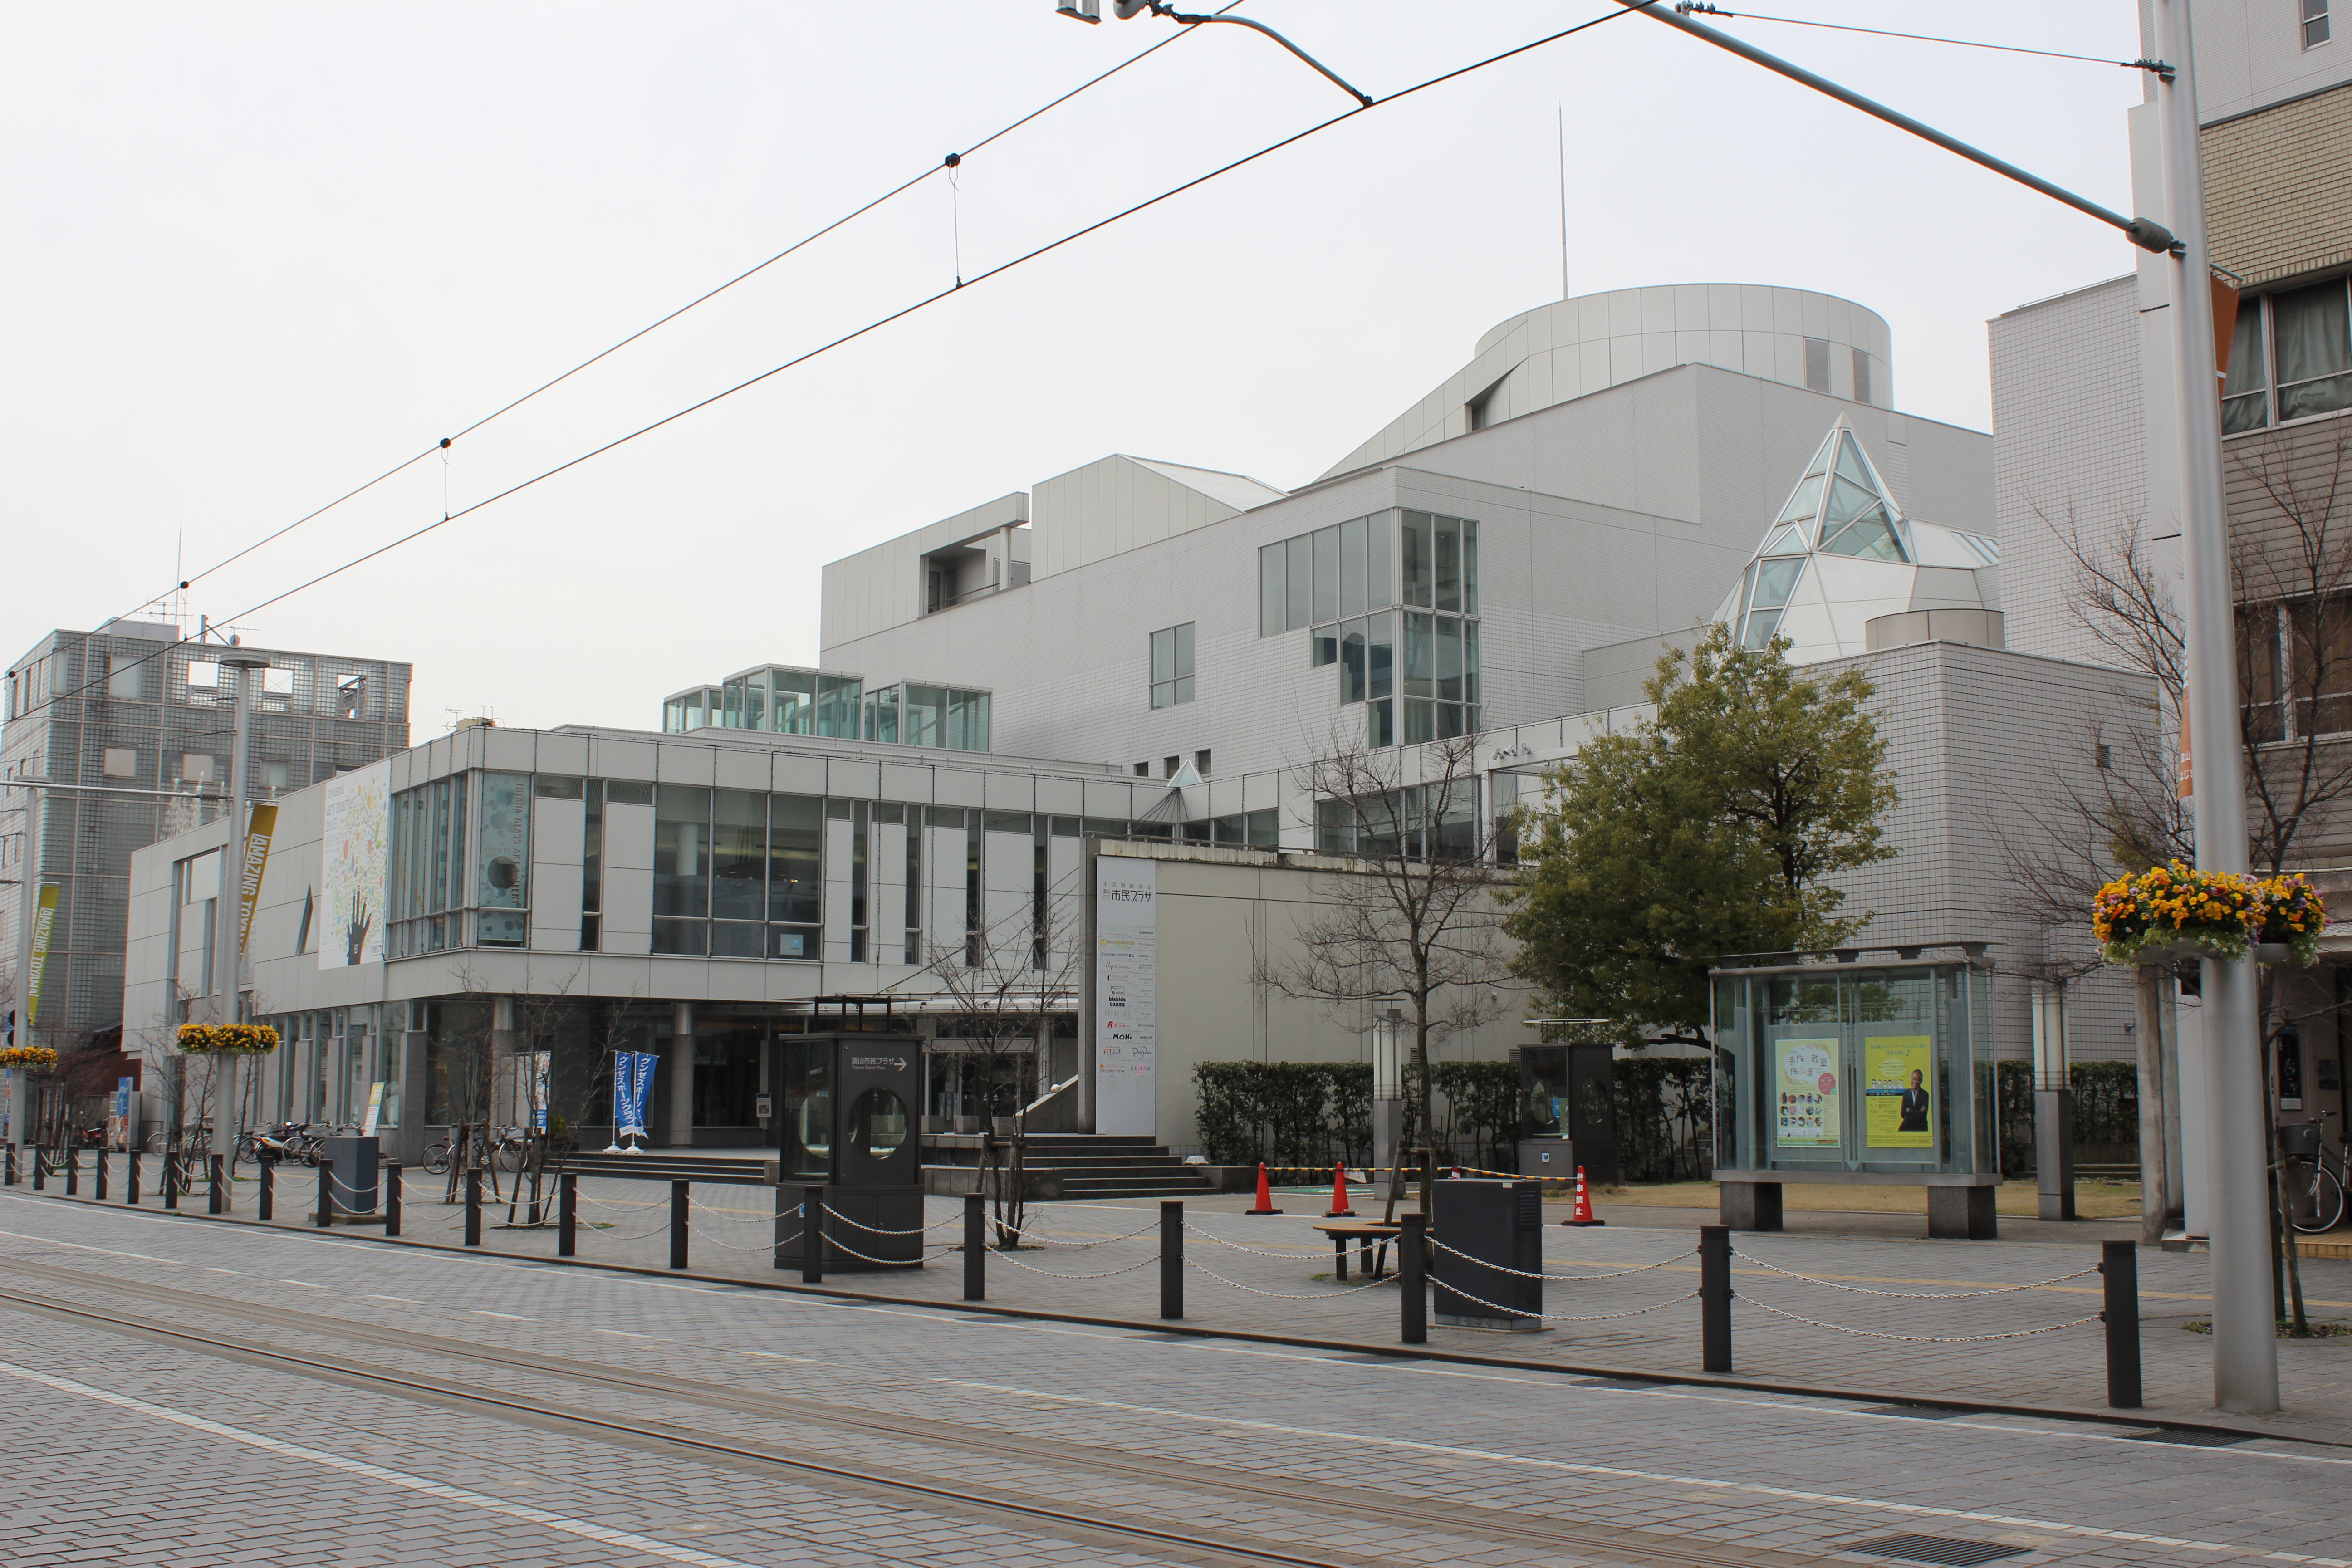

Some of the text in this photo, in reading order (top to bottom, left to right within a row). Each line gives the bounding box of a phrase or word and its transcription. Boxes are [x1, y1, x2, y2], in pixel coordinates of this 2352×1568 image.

[328, 786, 344, 800] toyama
[514, 783, 524, 813] TOYAMA
[326, 795, 356, 816] art market
[326, 818, 337, 832] 2015
[242, 835, 269, 896] AMAZING
[1112, 889, 1152, 902] 市民プラザ
[29, 908, 53, 995] AMAZING TOYAMA
[1788, 1054, 1828, 1067] 手作り教室
[1789, 1066, 1814, 1077] 作品展
[1575, 1173, 1584, 1215] 駐車禁止
